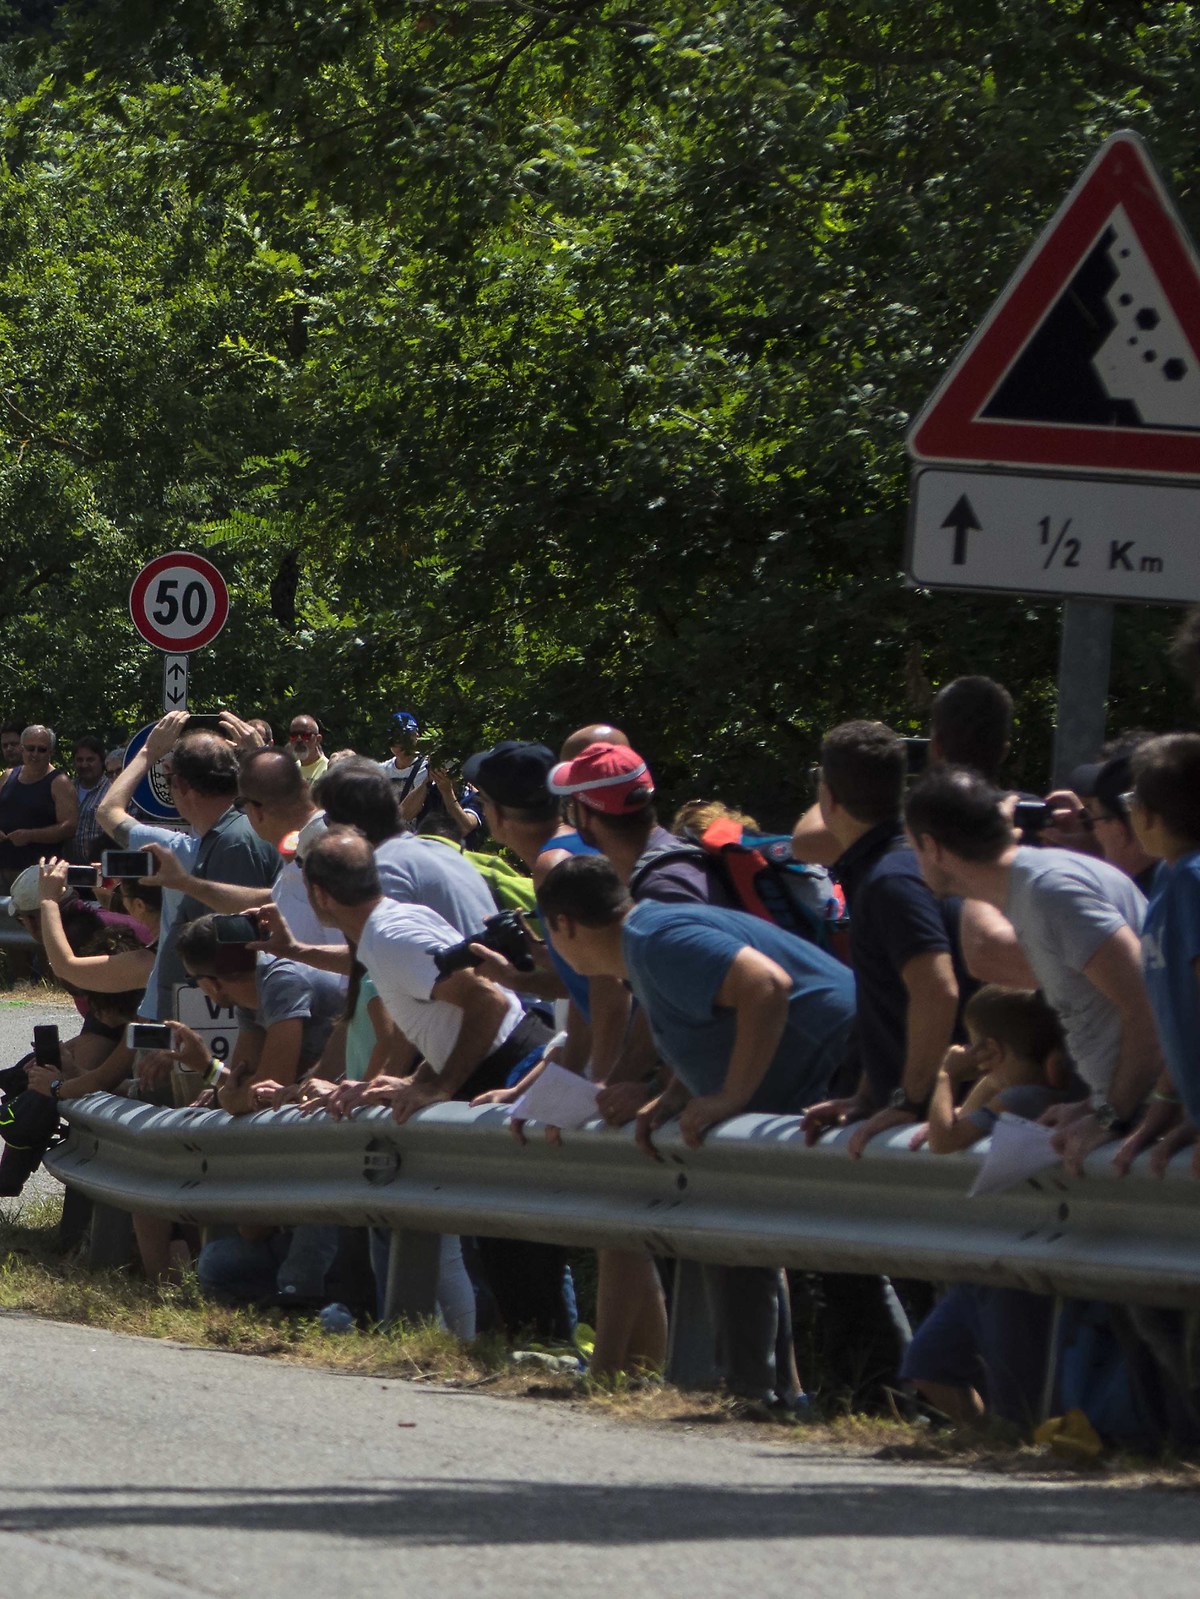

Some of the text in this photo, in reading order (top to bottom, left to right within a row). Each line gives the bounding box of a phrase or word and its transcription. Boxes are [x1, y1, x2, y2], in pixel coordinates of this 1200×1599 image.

[1109, 540, 1163, 573] Km
[152, 580, 208, 626] 50
[211, 1036, 229, 1060] 9
